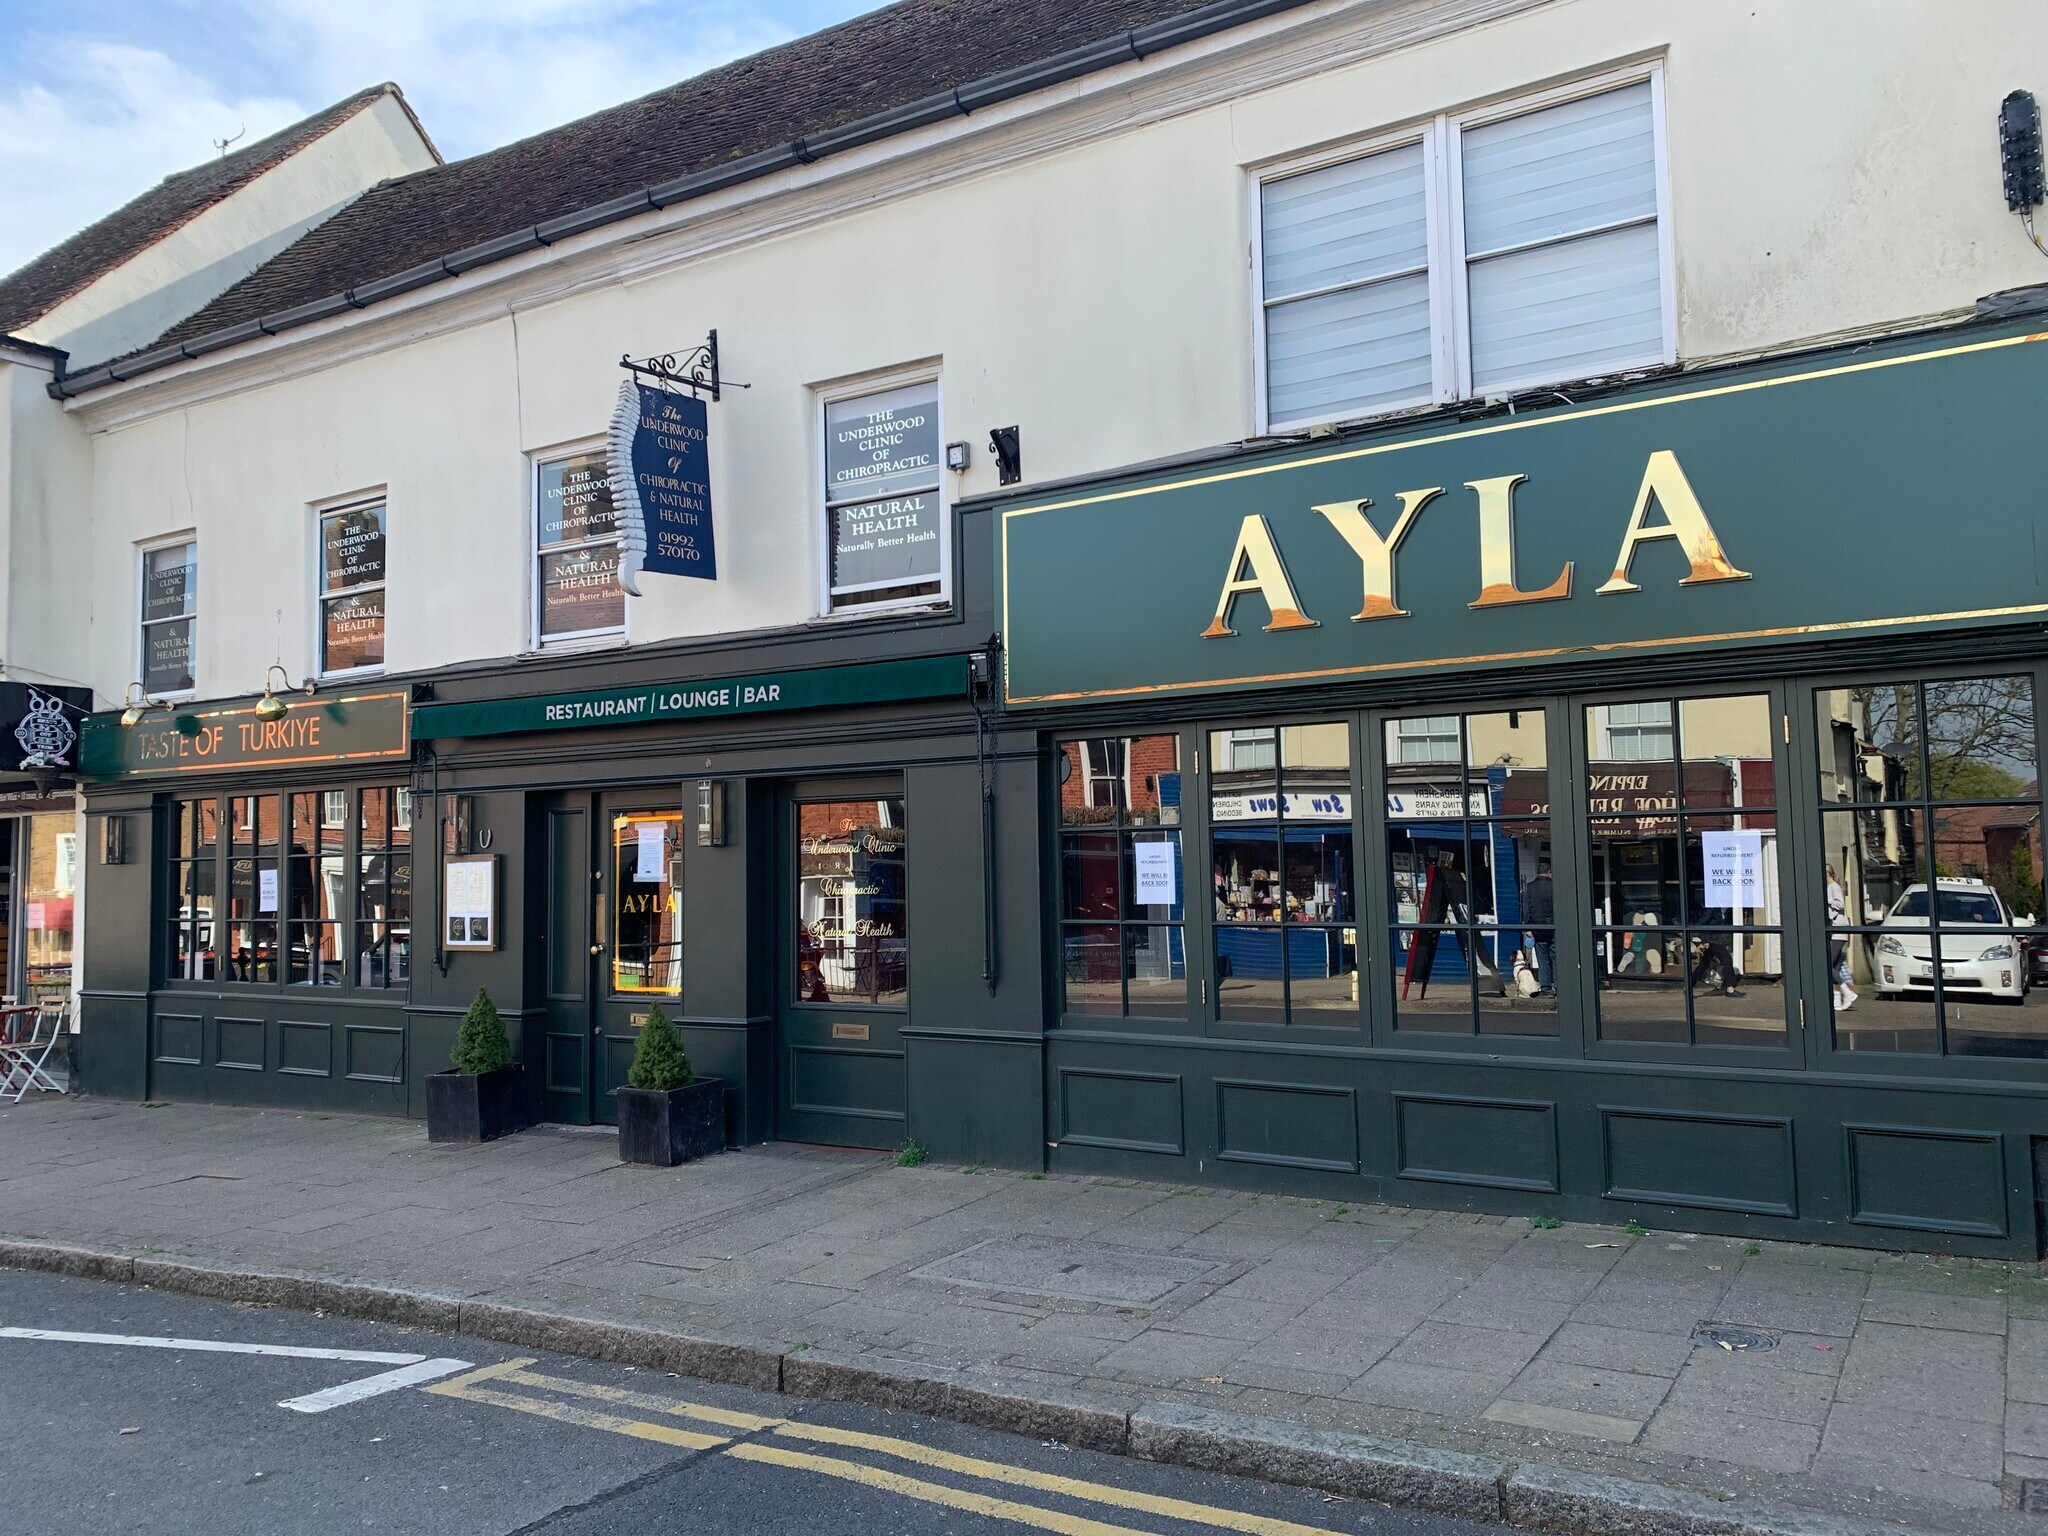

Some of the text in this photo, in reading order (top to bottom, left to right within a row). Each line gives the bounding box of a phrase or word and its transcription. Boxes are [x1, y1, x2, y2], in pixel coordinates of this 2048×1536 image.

[661, 404, 682, 422] The
[866, 409, 894, 424] THE
[641, 416, 704, 441] UNDERWOOD
[838, 416, 925, 443] UNDERWOOD
[657, 436, 690, 454] CLINIC
[859, 433, 903, 451] CLINIC
[872, 448, 890, 461] OF
[836, 454, 930, 481] CHIROPRACTIC
[570, 470, 591, 483] THE
[639, 472, 707, 496] CHIROPRACTIC
[563, 492, 598, 507] CLINIC
[650, 491, 705, 511] & NATURAL
[573, 505, 587, 515] OF
[659, 508, 698, 526] HEALTH
[845, 497, 925, 521] NATURAL
[545, 511, 616, 532] CHIROPRACTIC
[852, 514, 918, 536] HEALTH
[344, 525, 361, 536] THE
[658, 531, 695, 547] 01992
[327, 531, 379, 550] UNDERWOOD
[836, 530, 936, 554] Naturally Better Health
[1199, 449, 1753, 640] AYLA
[339, 544, 366, 557] CLINIC
[579, 550, 591, 560] &
[657, 544, 700, 561] 570170
[347, 556, 358, 565] OF
[555, 559, 617, 577] NATURAL
[150, 565, 192, 580] UNDERWOOD
[326, 561, 380, 579] CHIROPRACTIC
[159, 577, 182, 588] CLINIC
[560, 574, 611, 590] HEALTH
[148, 592, 194, 606] CHIROPRACTIC
[165, 587, 175, 596] OF
[547, 588, 625, 606] Naturally Better Health
[351, 596, 360, 606] &
[333, 606, 380, 621] NATURAL
[168, 628, 177, 637] &
[336, 618, 375, 633] HEALTH
[153, 636, 192, 650] NATURAL
[327, 637, 350, 647] Naturally
[351, 635, 367, 643] Better
[156, 647, 189, 660] HEALTH
[545, 684, 780, 720] RESTAURANT LOUNGE BAR
[139, 716, 320, 760] TASTE OF TURKIYE
[840, 818, 857, 831] The
[803, 834, 897, 855] Underwood Clinic
[820, 877, 880, 897] Chiropractic
[623, 894, 678, 913] AYLA
[808, 919, 895, 939] Natural Health
